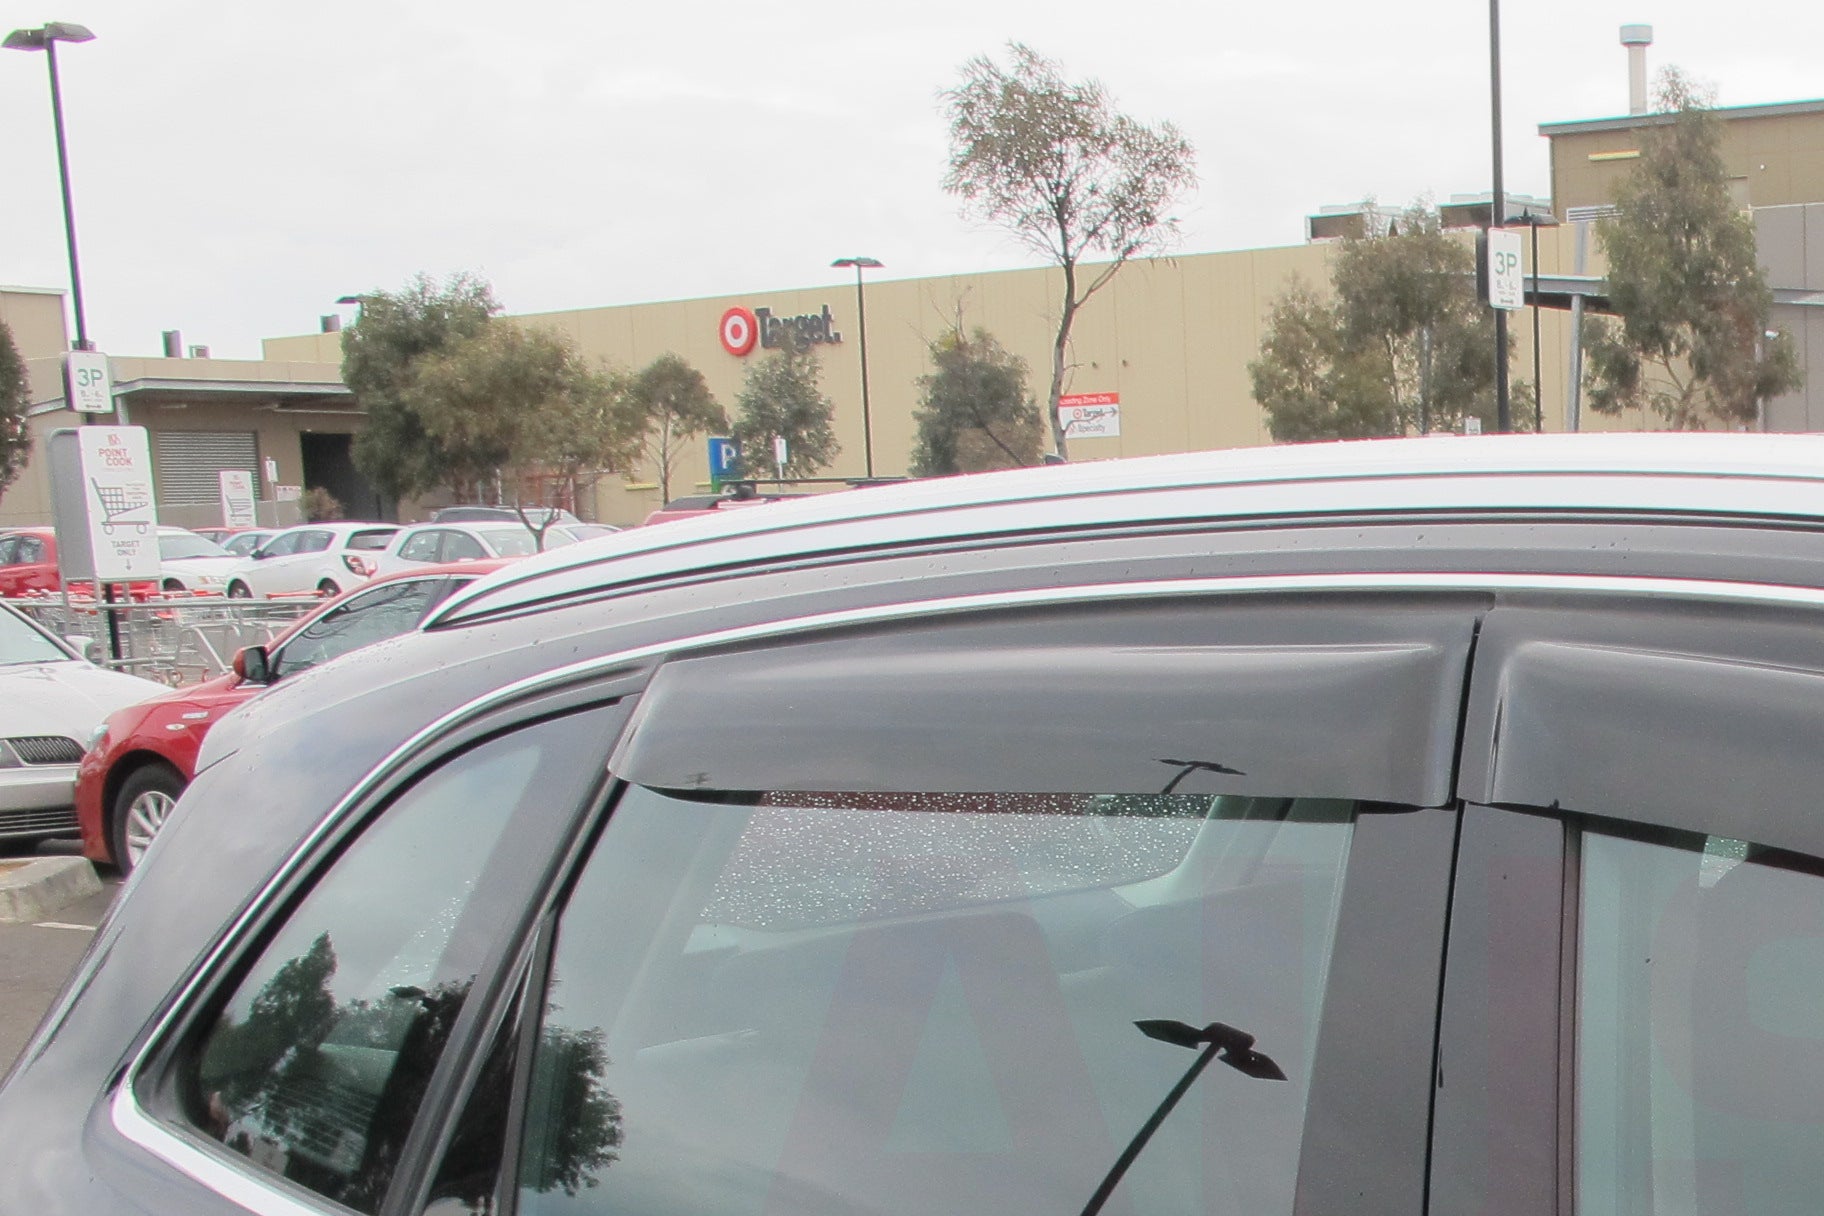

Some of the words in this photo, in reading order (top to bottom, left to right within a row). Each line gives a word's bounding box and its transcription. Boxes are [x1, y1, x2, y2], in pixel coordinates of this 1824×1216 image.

[1495, 251, 1517, 276] 3P
[77, 368, 103, 387] 3P
[99, 448, 128, 458] POINT
[721, 444, 737, 469] P
[106, 457, 133, 466] COOK
[111, 540, 140, 549] TARGET
